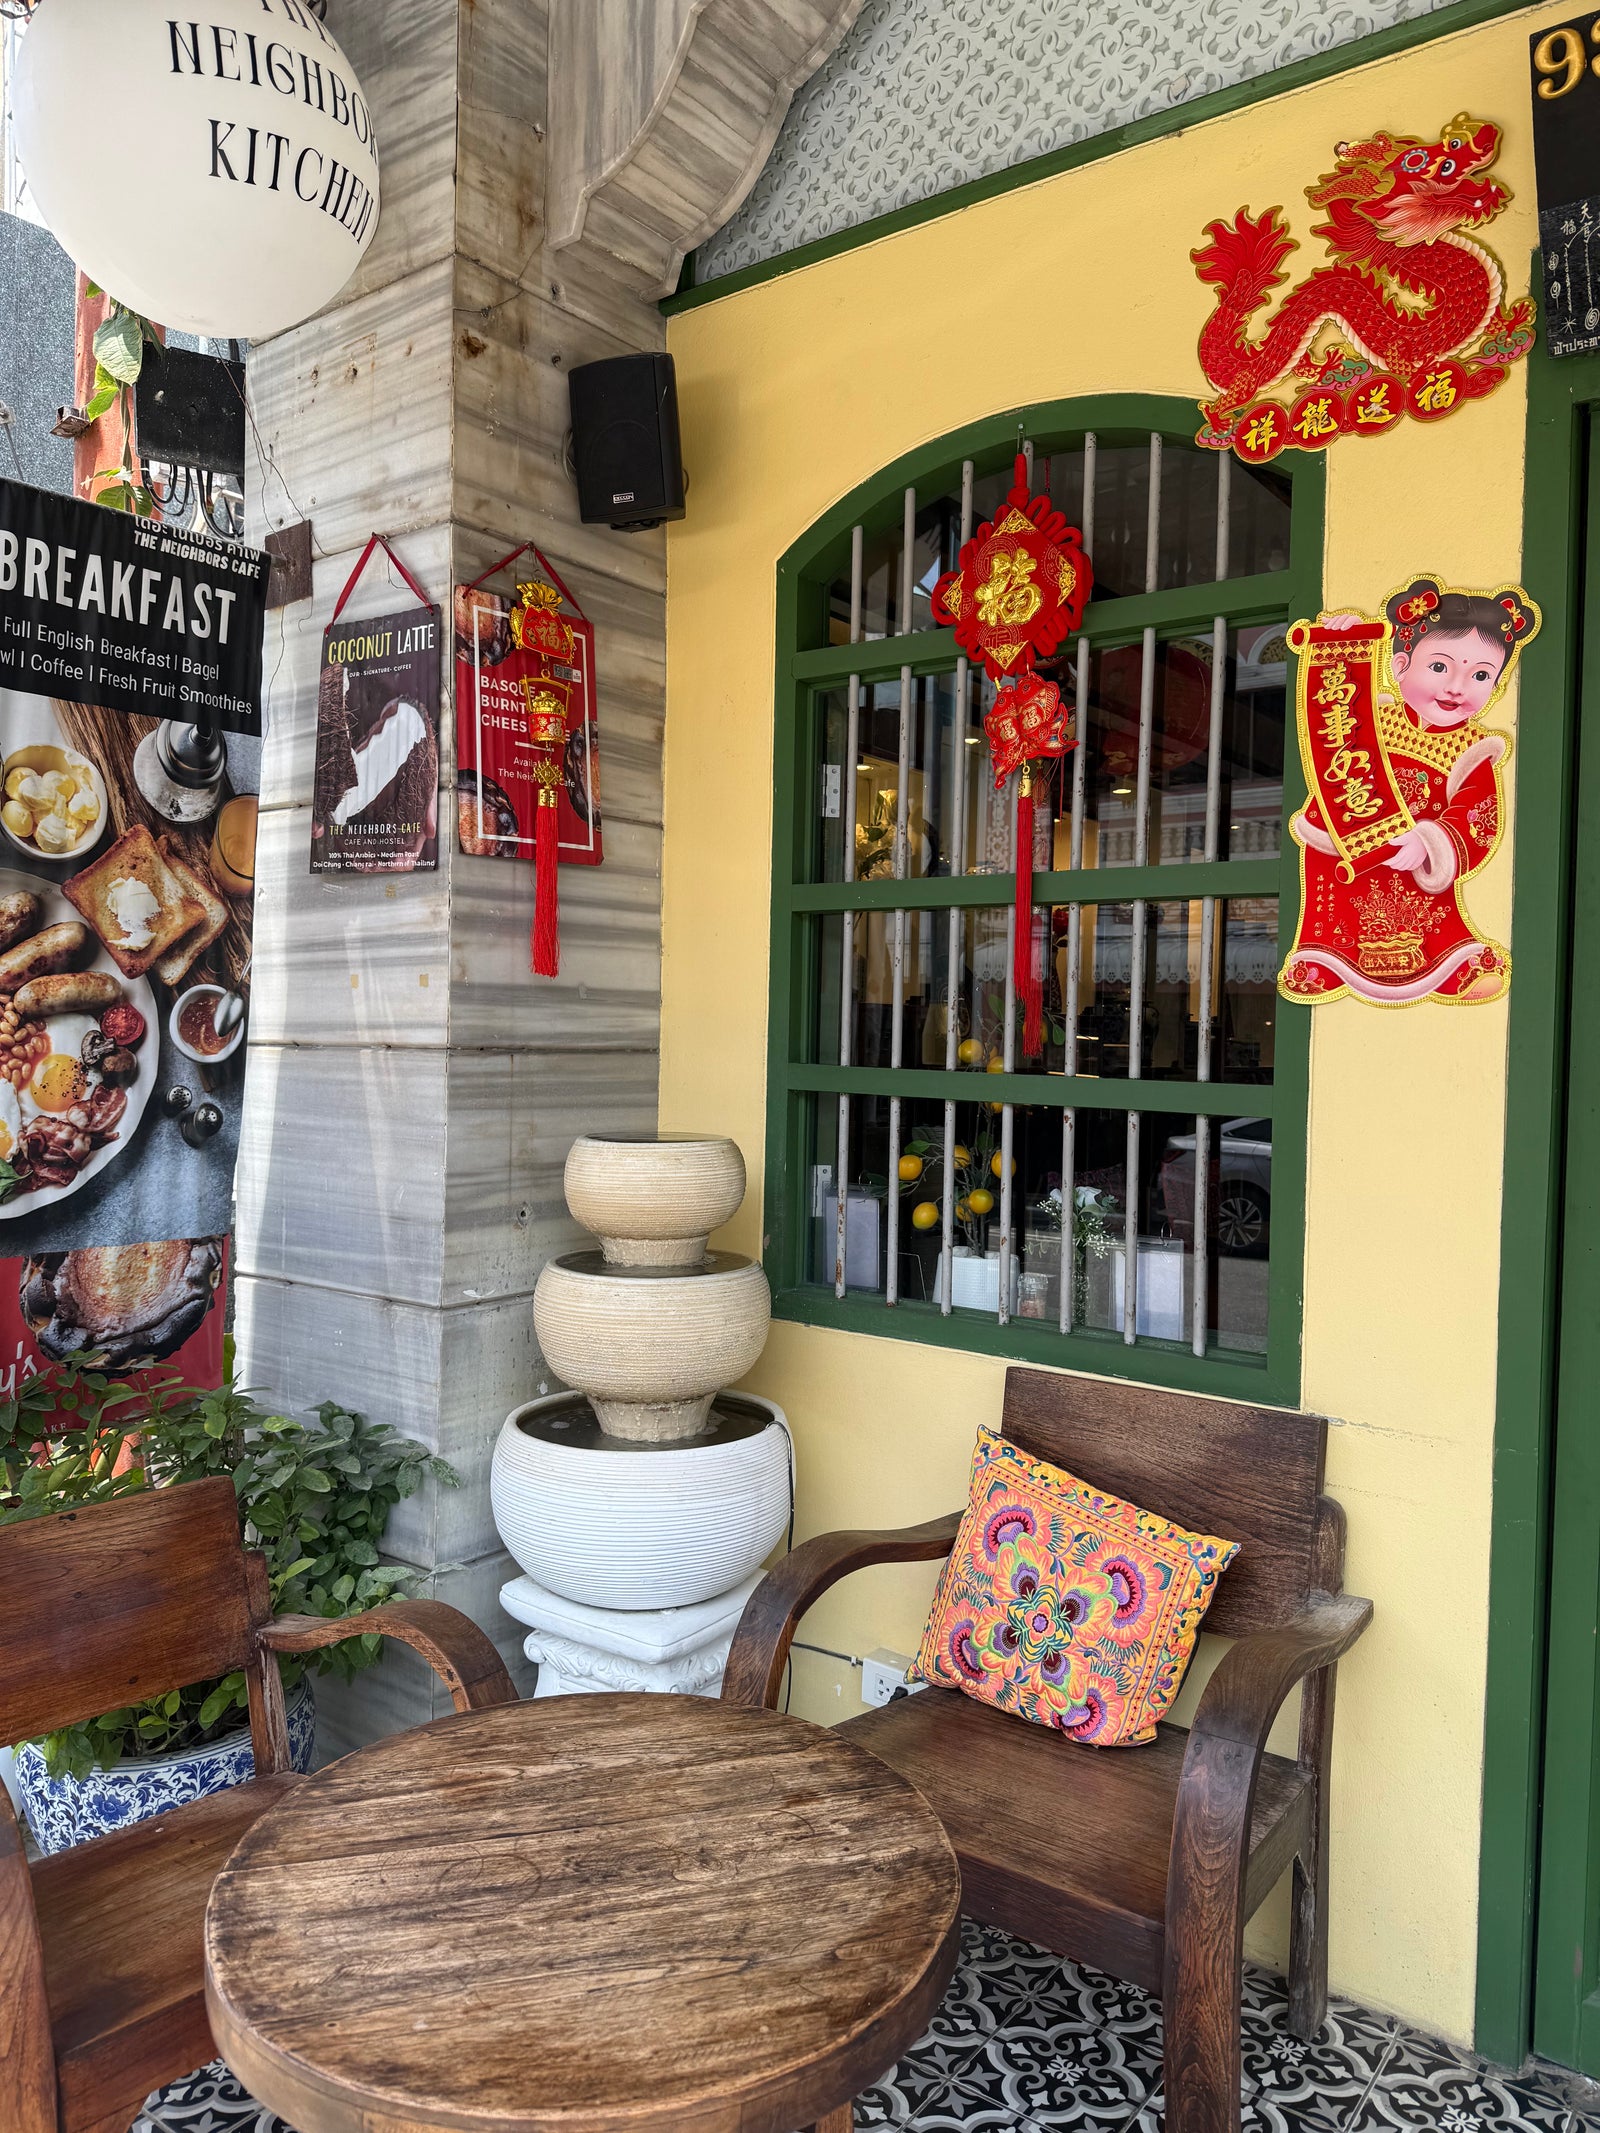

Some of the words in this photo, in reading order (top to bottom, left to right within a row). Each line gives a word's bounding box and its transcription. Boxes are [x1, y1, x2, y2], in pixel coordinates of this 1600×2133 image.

[207, 118, 375, 244] KITCHEN
[1241, 368, 1459, 454] 祥龍送福
[134, 530, 158, 550] THE
[161, 538, 228, 570] NEIGHBORS
[231, 558, 261, 580] CAFE
[0, 529, 237, 646] BREAKFAST
[974, 547, 1042, 628] 福
[4, 615, 31, 639] Full
[37, 623, 95, 652] English
[100, 637, 171, 669] Breakfast
[182, 657, 219, 680] Bagel
[328, 631, 393, 665] COCONUT
[397, 623, 435, 655] LATTE
[393, 663, 412, 672] COFFEE
[31, 653, 84, 680] Coffee
[99, 667, 138, 692] Fresh
[142, 677, 176, 699] Fruit
[179, 685, 253, 715] Smoothies
[481, 694, 527, 715] BURNT
[1313, 661, 1383, 823] 萬事如意
[498, 767, 515, 778] The
[329, 825, 344, 836] THE
[348, 823, 397, 835] NEIGHBORS
[401, 822, 421, 834] CAFE
[344, 838, 361, 846] CAFE
[363, 838, 377, 846] AND
[380, 837, 405, 846] HOSTEL
[342, 851, 354, 859] Thai
[354, 851, 376, 859] Arabica
[380, 850, 403, 858] Medium
